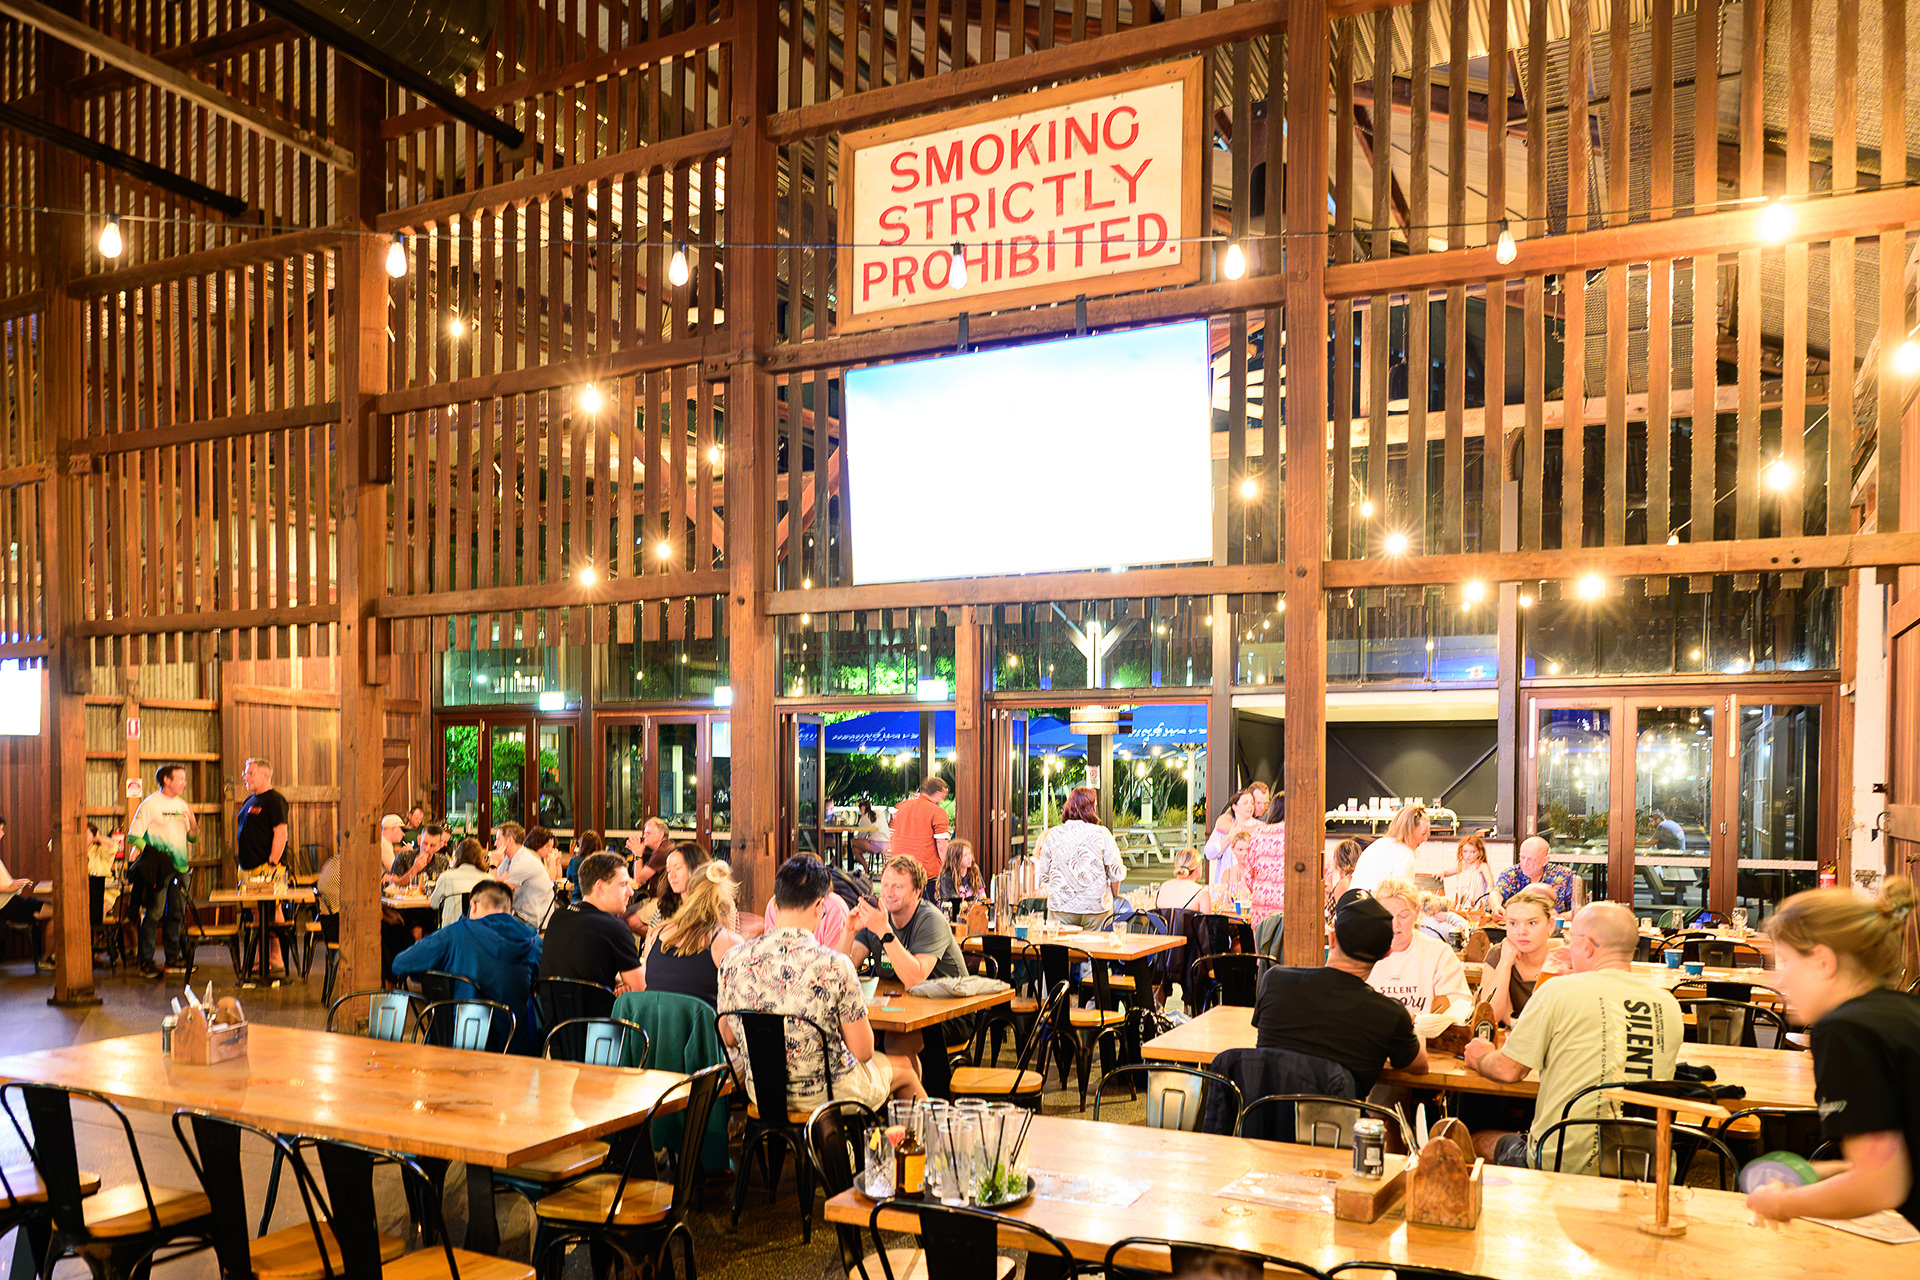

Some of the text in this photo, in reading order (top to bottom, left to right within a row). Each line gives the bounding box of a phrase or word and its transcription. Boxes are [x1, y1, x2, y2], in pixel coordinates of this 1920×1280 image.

[890, 105, 1140, 194] SMOKING
[879, 157, 1154, 246] STRICTLY
[863, 212, 1177, 302] PROHIBITED.
[1380, 986, 1418, 994] SILENT
[1624, 999, 1653, 1079] SILENT
